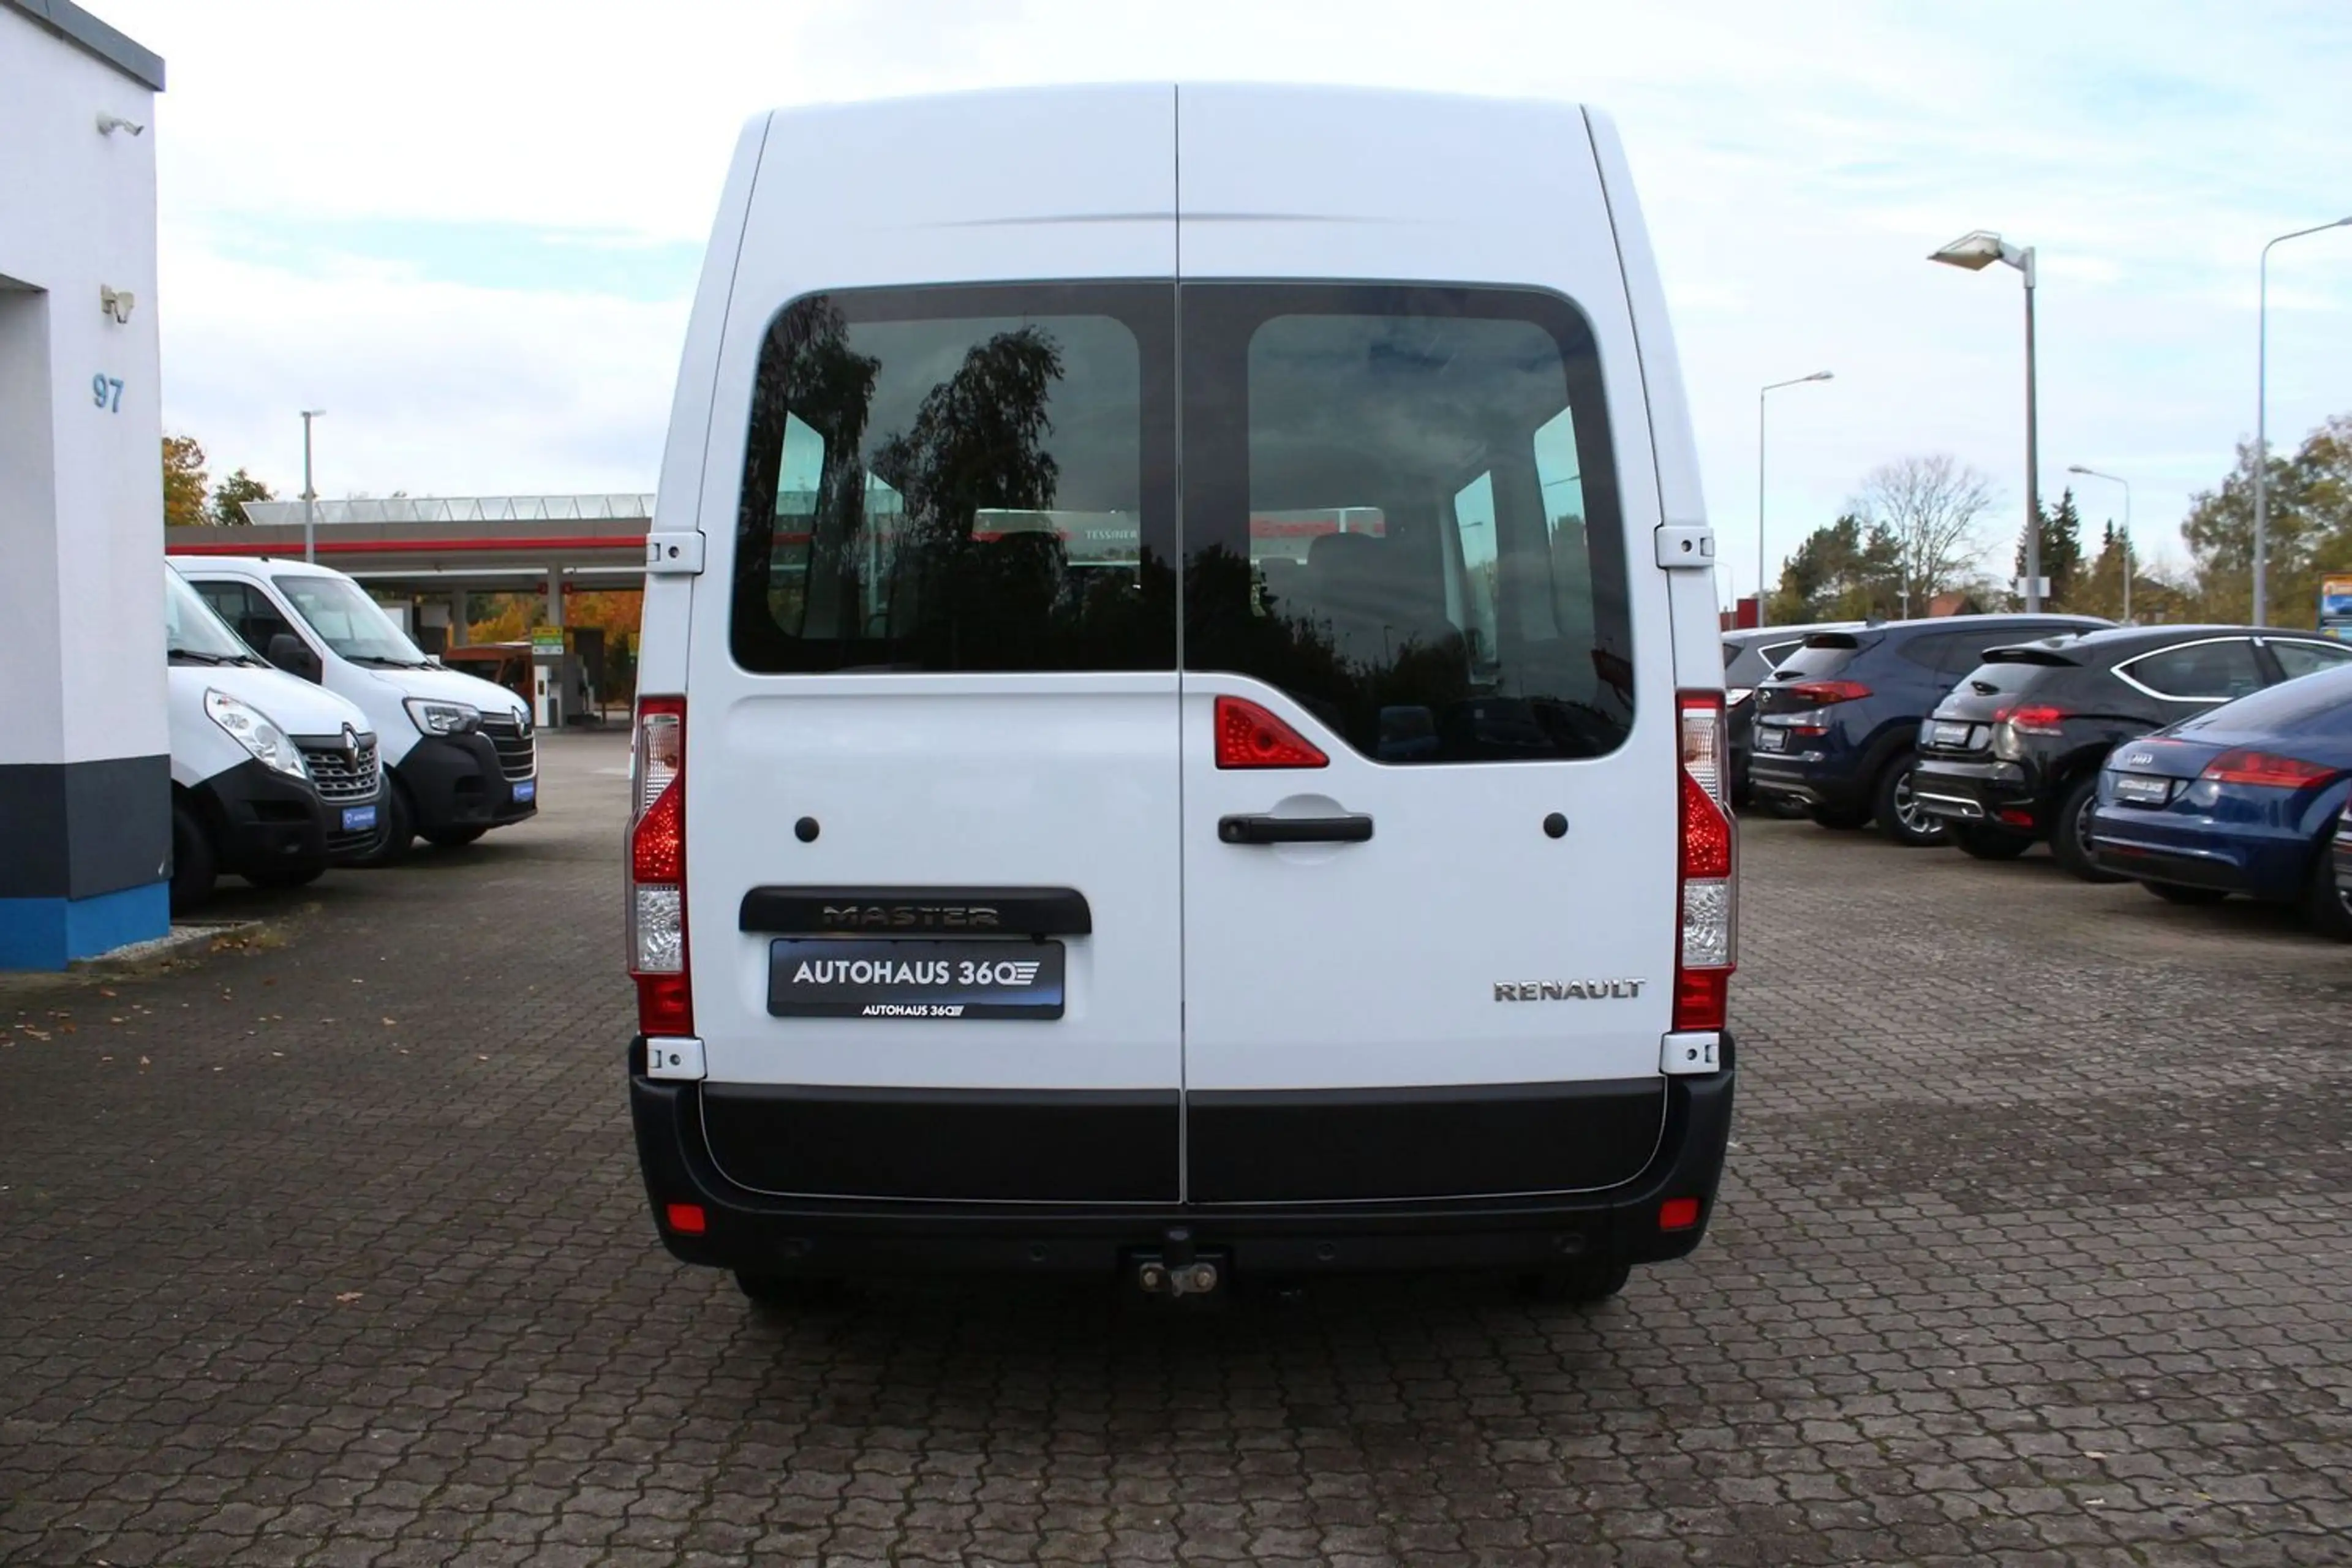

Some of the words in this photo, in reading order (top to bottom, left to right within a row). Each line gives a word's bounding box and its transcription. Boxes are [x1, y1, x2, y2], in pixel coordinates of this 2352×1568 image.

[93, 373, 124, 413] 97
[823, 905, 999, 926] MASTER
[793, 960, 949, 984] AUTOHAUS
[1494, 978, 1646, 1002] RENAULT
[862, 1005, 927, 1016] AUTOHAUS
